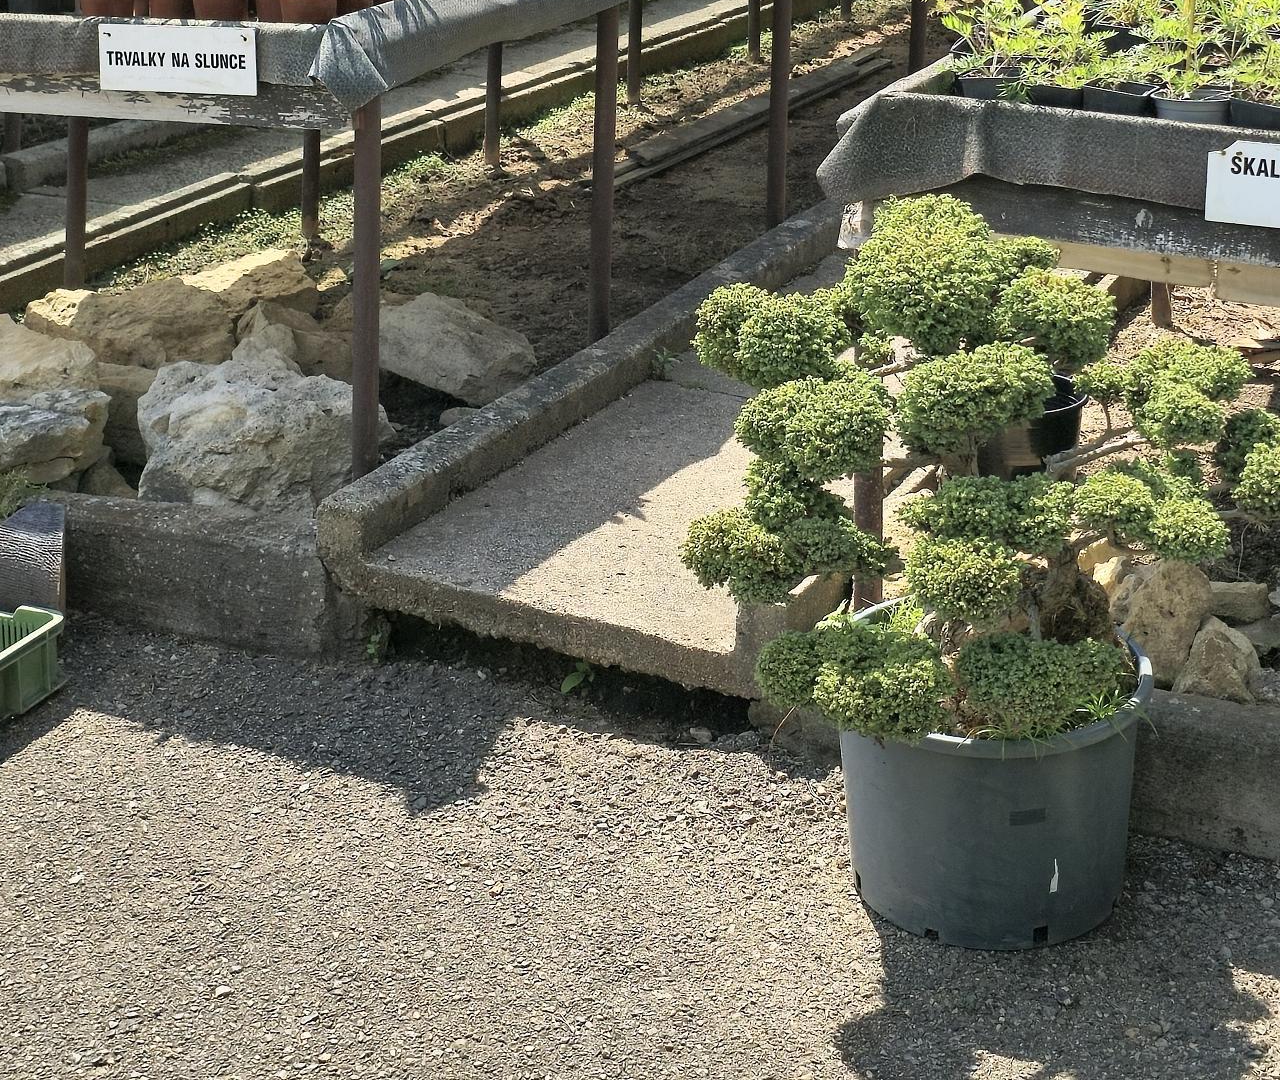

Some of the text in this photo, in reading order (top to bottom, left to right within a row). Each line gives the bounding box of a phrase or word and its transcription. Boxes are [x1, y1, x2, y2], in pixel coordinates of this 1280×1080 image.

[106, 50, 246, 70] TRVALKY NA SLUNCE
